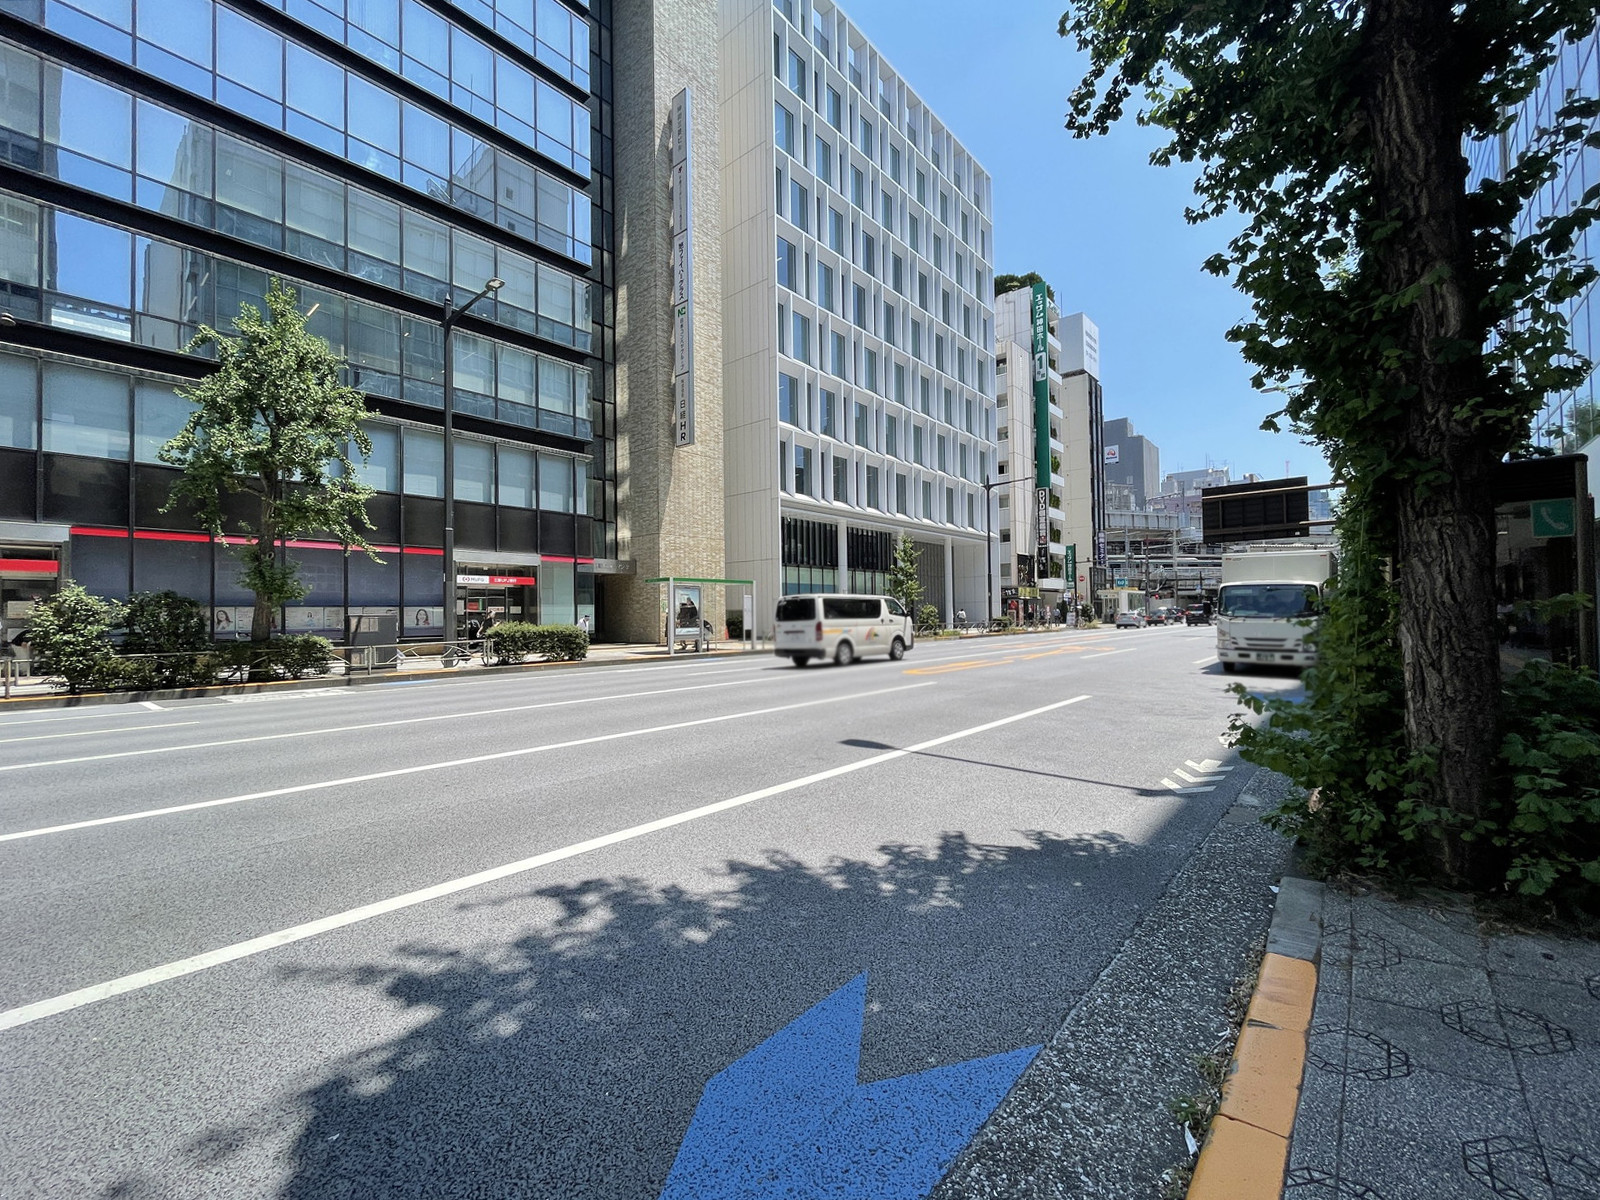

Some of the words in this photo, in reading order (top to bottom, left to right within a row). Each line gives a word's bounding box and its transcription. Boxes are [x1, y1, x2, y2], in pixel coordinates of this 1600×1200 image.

[1036, 293, 1044, 352] エッサム神田ホール
